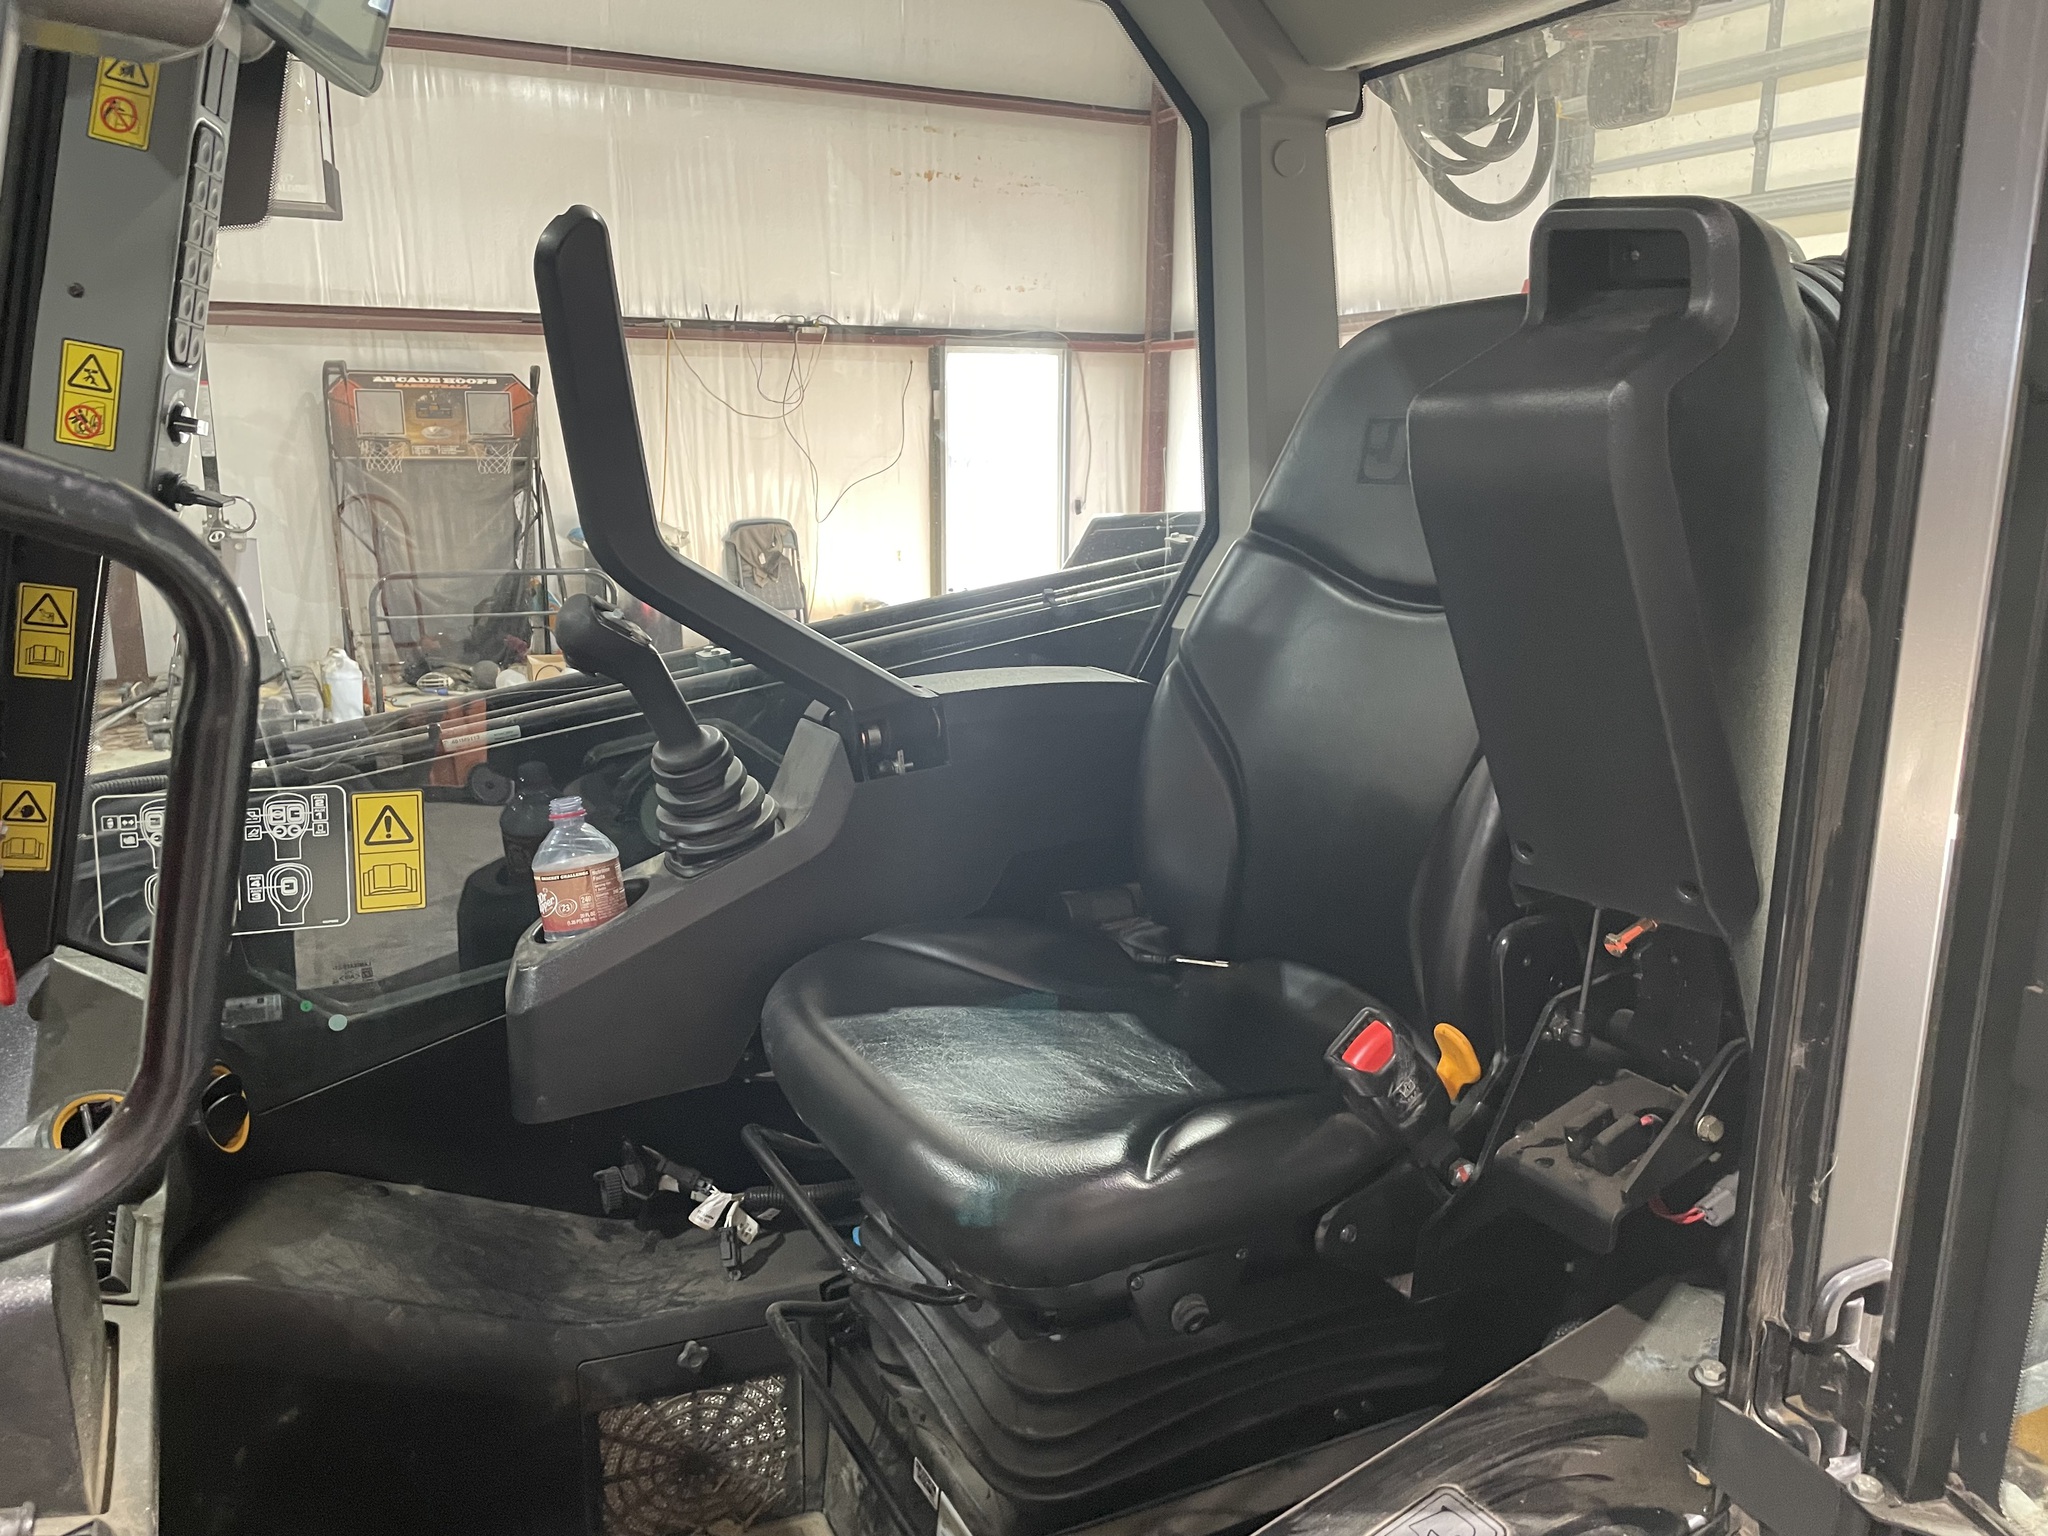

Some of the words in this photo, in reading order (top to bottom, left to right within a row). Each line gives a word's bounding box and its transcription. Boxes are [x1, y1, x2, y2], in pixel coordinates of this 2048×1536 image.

[442, 377, 498, 385] HOOPS
[315, 812, 323, 820] 1
[251, 880, 261, 888] 4
[251, 893, 262, 901] 3
[580, 895, 592, 904] 240
[560, 904, 570, 912] 23
